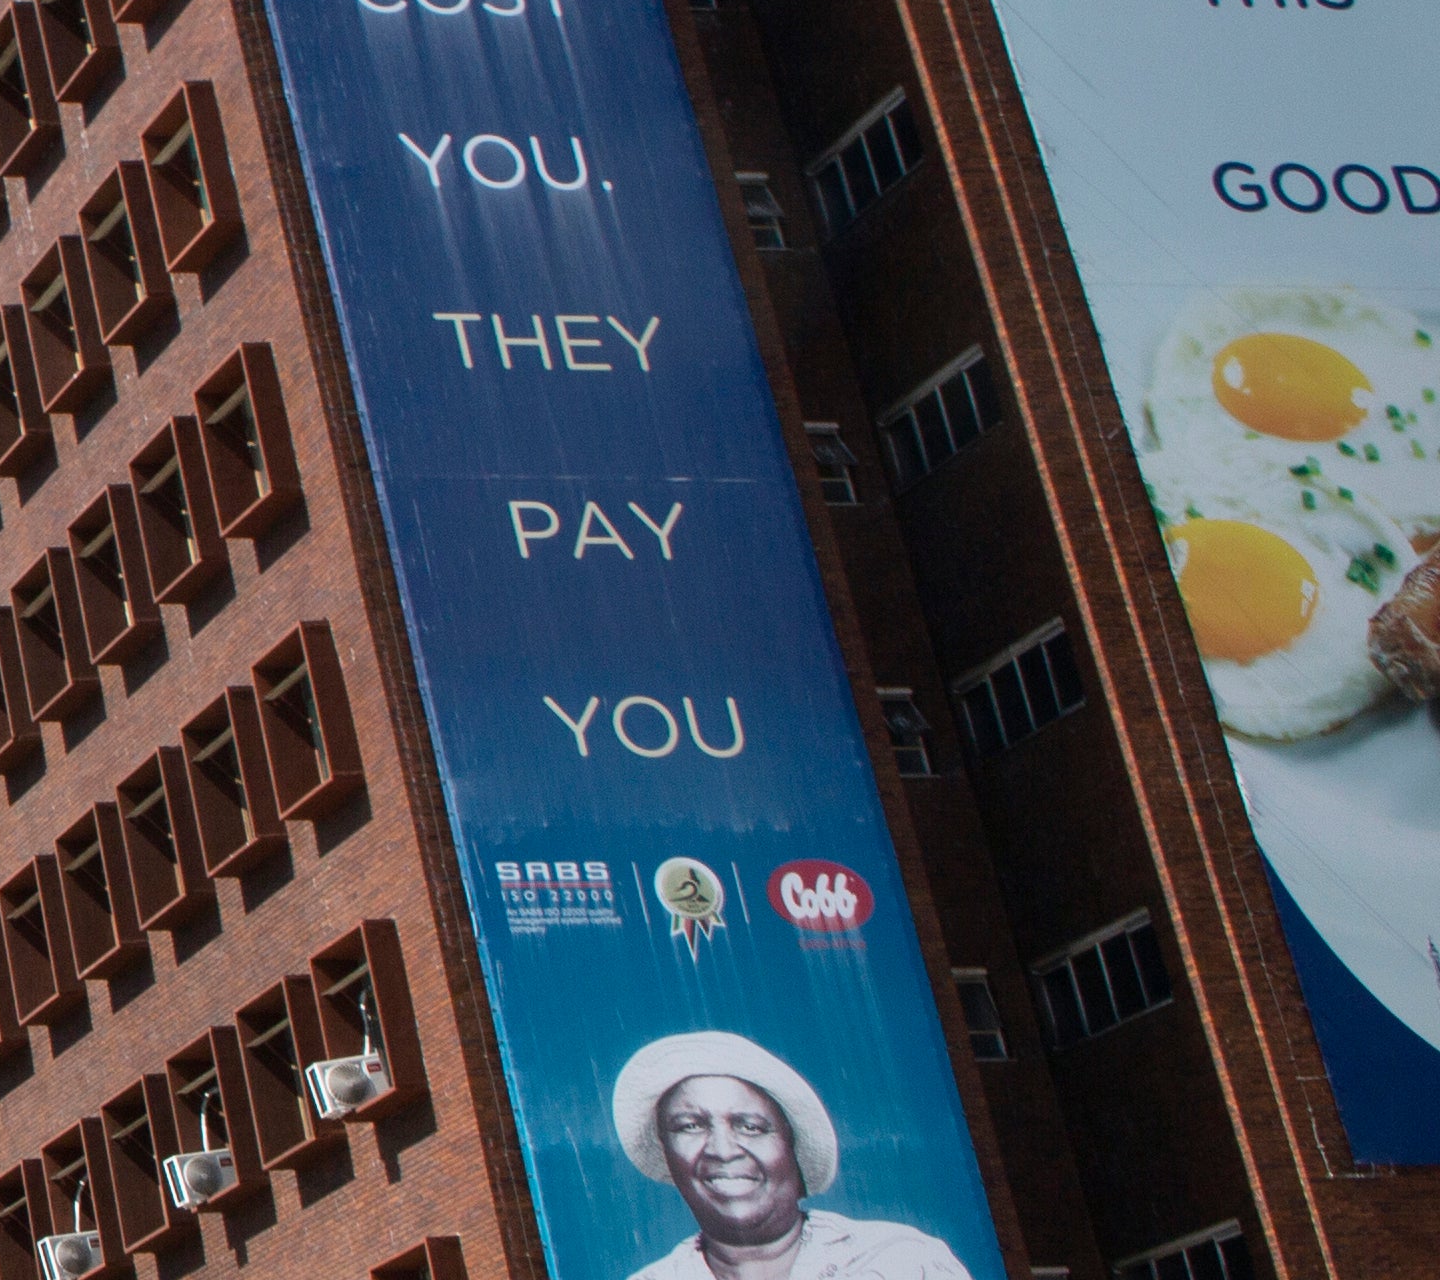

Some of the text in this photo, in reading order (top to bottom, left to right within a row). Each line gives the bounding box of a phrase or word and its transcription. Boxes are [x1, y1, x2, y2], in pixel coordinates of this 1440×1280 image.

[398, 132, 613, 192] YOU.
[1211, 161, 1440, 215] GOOD
[432, 313, 660, 373] THEY
[508, 500, 683, 560] PAY
[542, 695, 745, 759] YOU
[495, 861, 611, 882] SABS
[500, 888, 615, 903] ISO 22000
[781, 872, 858, 919] Cobb
